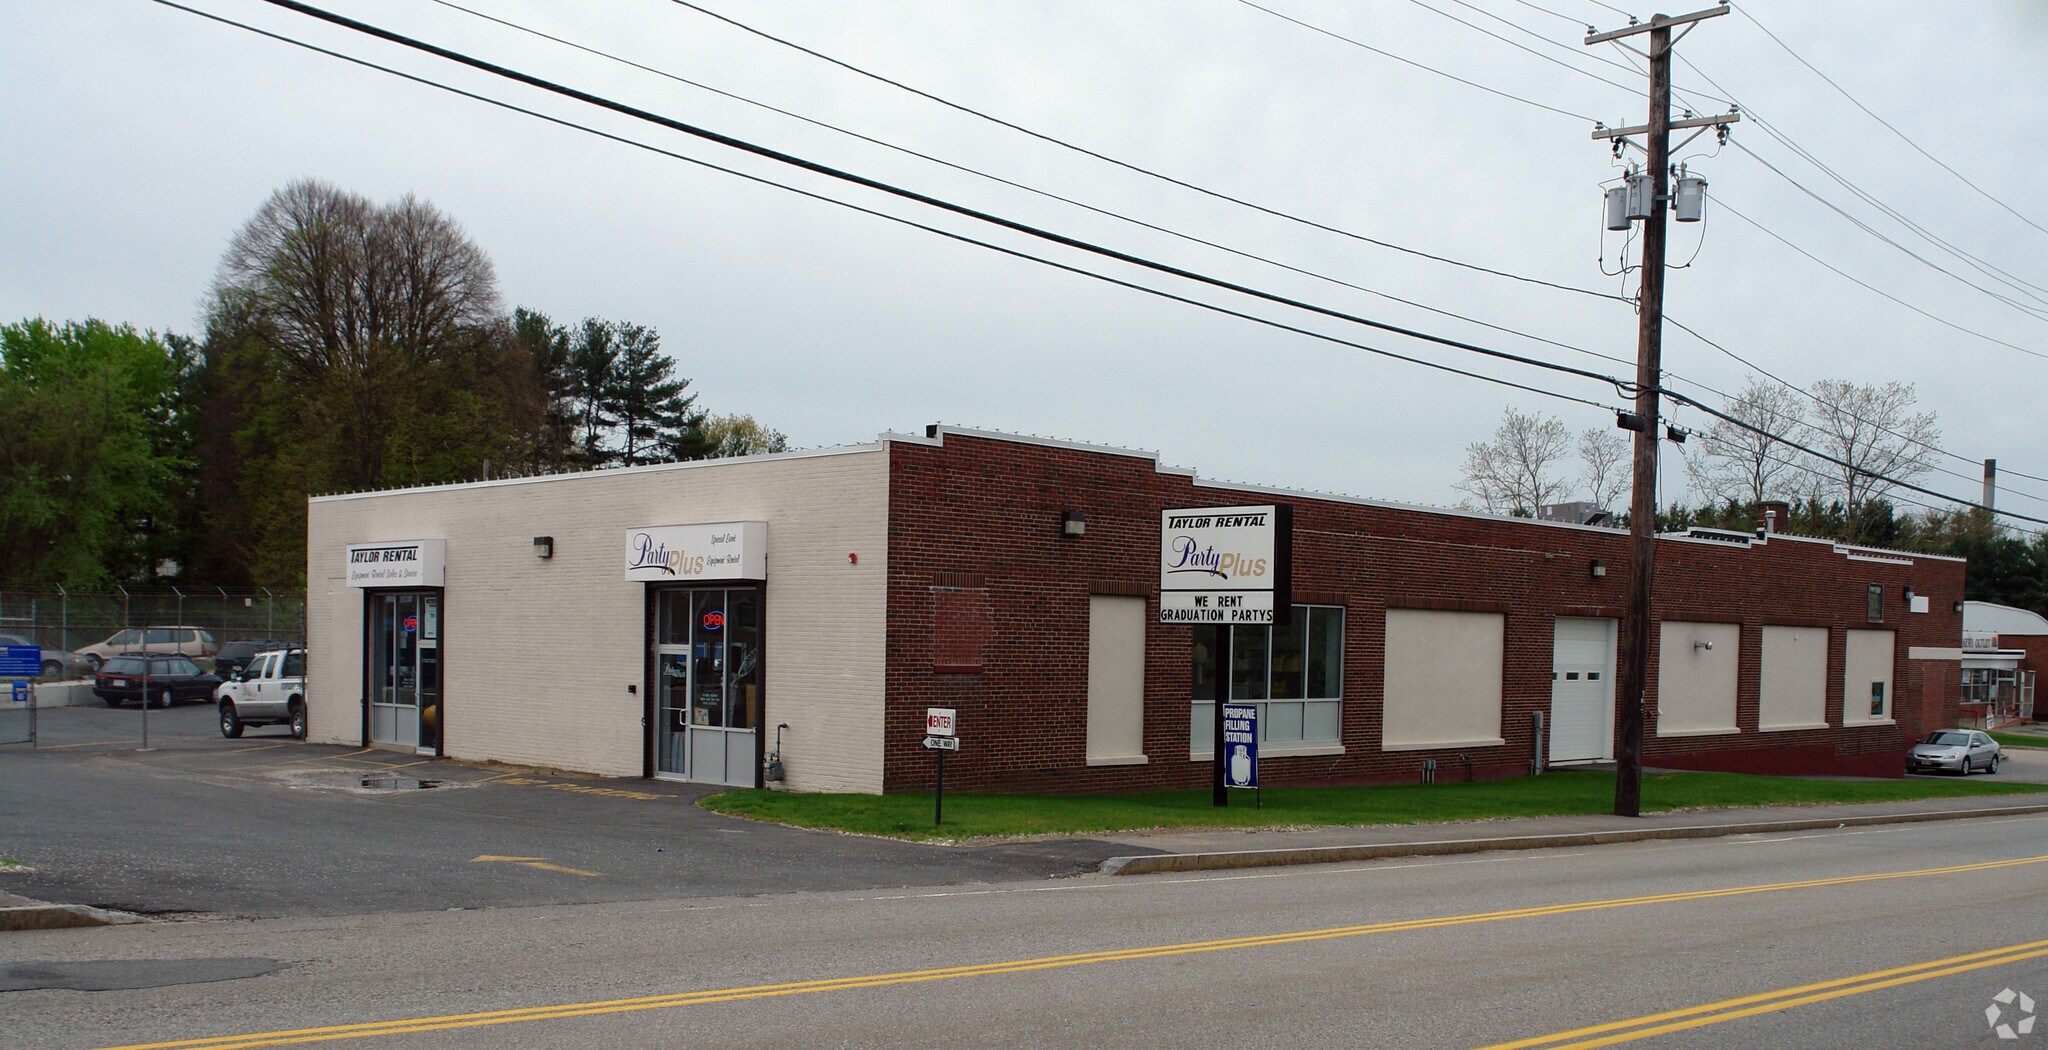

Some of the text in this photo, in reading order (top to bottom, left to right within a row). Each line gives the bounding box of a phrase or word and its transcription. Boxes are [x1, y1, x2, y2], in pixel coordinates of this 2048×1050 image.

[1168, 516, 1266, 529] TAYLOR RENTAL
[351, 549, 417, 563] TAYLOR RENTAL
[629, 533, 704, 575] Party Plus
[1167, 536, 1267, 577] Party Plus
[1195, 596, 1243, 607] WE RENT
[1161, 609, 1273, 621] GRADUATION PARTYS
[1225, 708, 1256, 719] PROPANE
[934, 716, 951, 728] ENTER
[1225, 720, 1250, 731] FILLING
[931, 739, 941, 747] ONE
[1225, 732, 1253, 743] STATION
